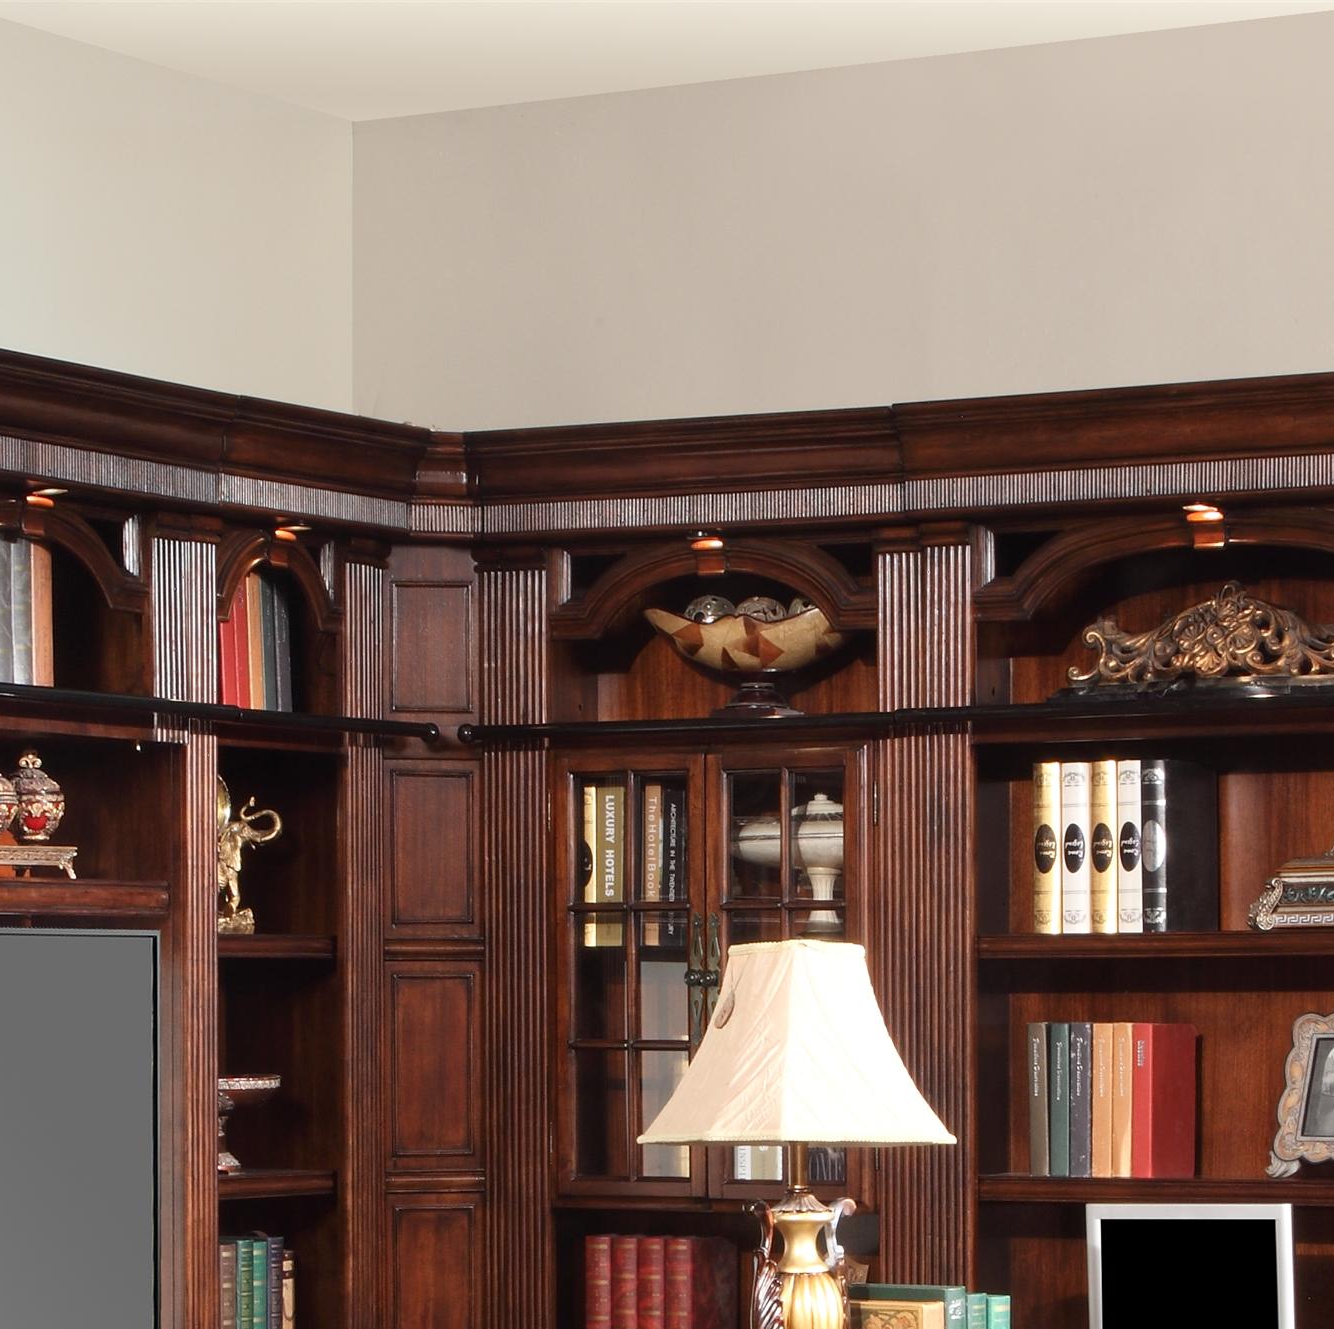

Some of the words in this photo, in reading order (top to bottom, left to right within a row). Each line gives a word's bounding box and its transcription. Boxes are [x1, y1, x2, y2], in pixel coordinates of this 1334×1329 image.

[604, 795, 615, 844] LUXURY
[648, 796, 658, 823] The
[669, 803, 677, 847] ARCHITECTURE
[647, 824, 657, 861] Hotel
[604, 849, 616, 897] HOTELS
[647, 863, 656, 898] Book
